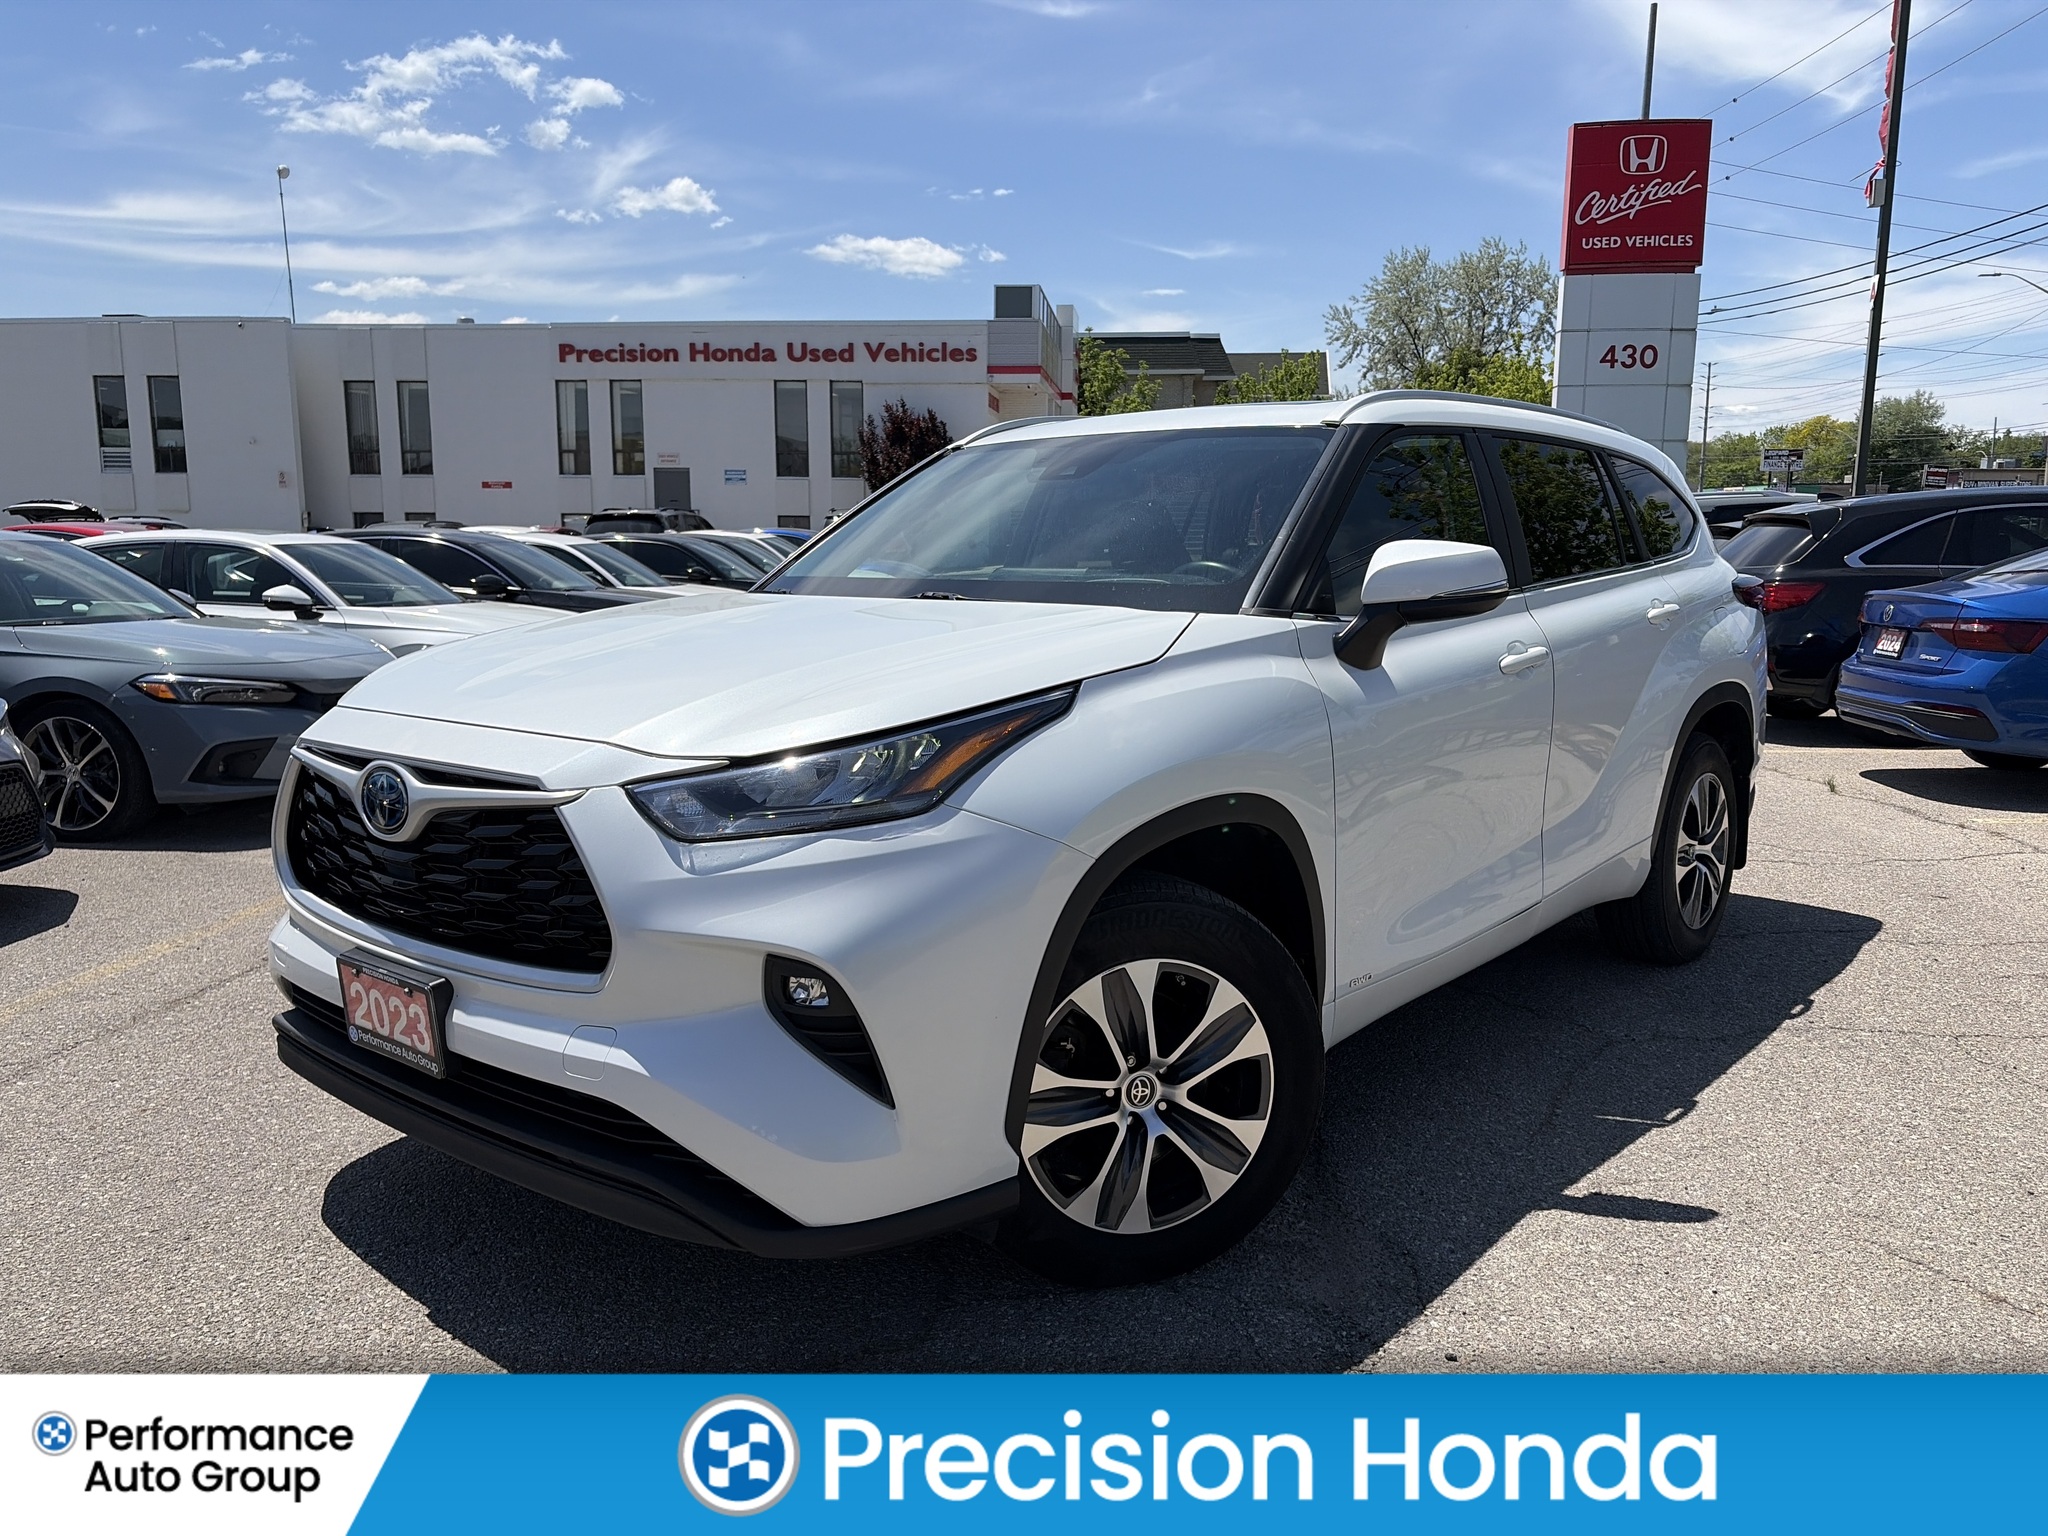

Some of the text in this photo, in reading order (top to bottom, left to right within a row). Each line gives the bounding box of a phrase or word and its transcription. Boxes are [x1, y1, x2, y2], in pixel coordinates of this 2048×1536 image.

[1574, 170, 1702, 225] Certified
[1582, 234, 1693, 249] USED VEHICLES
[558, 342, 978, 363] Precision Honda Used Vehicles
[1599, 344, 1658, 369] 430
[1876, 634, 1903, 652] 2024
[1349, 972, 1373, 988] AWD
[350, 981, 431, 1053] 2023
[358, 1029, 438, 1074] Performance Auto Group
